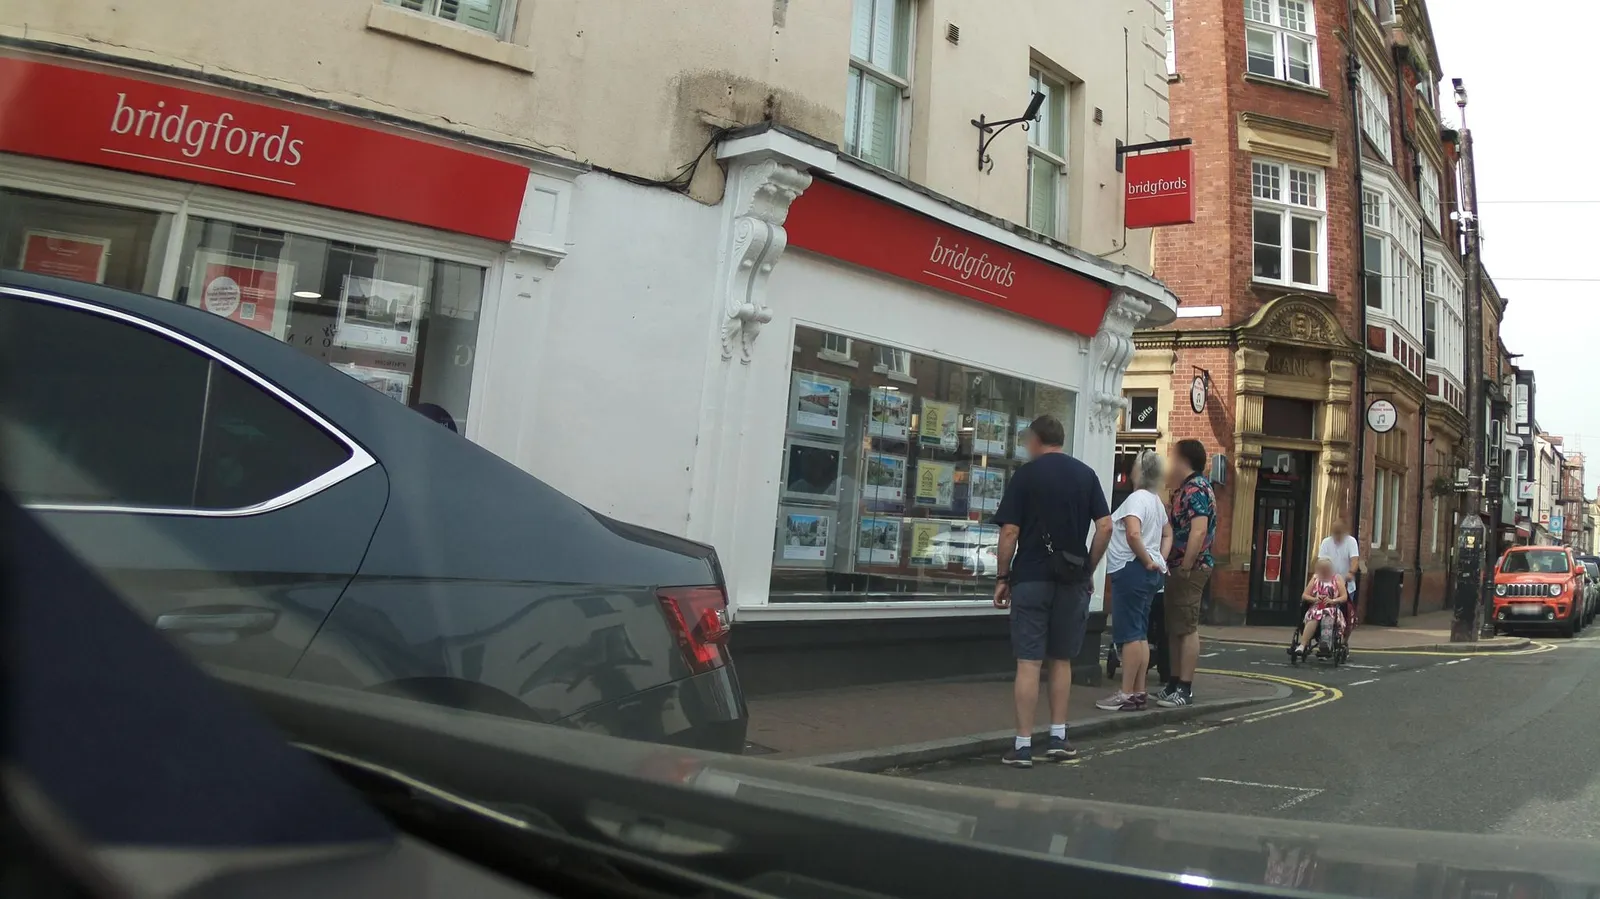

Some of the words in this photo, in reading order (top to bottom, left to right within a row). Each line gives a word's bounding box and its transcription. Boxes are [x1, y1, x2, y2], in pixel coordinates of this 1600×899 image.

[110, 92, 304, 166] bridgfords
[1128, 176, 1187, 195] bridgfords
[930, 236, 1016, 287] bridgfords
[1137, 405, 1153, 423] Gifts
